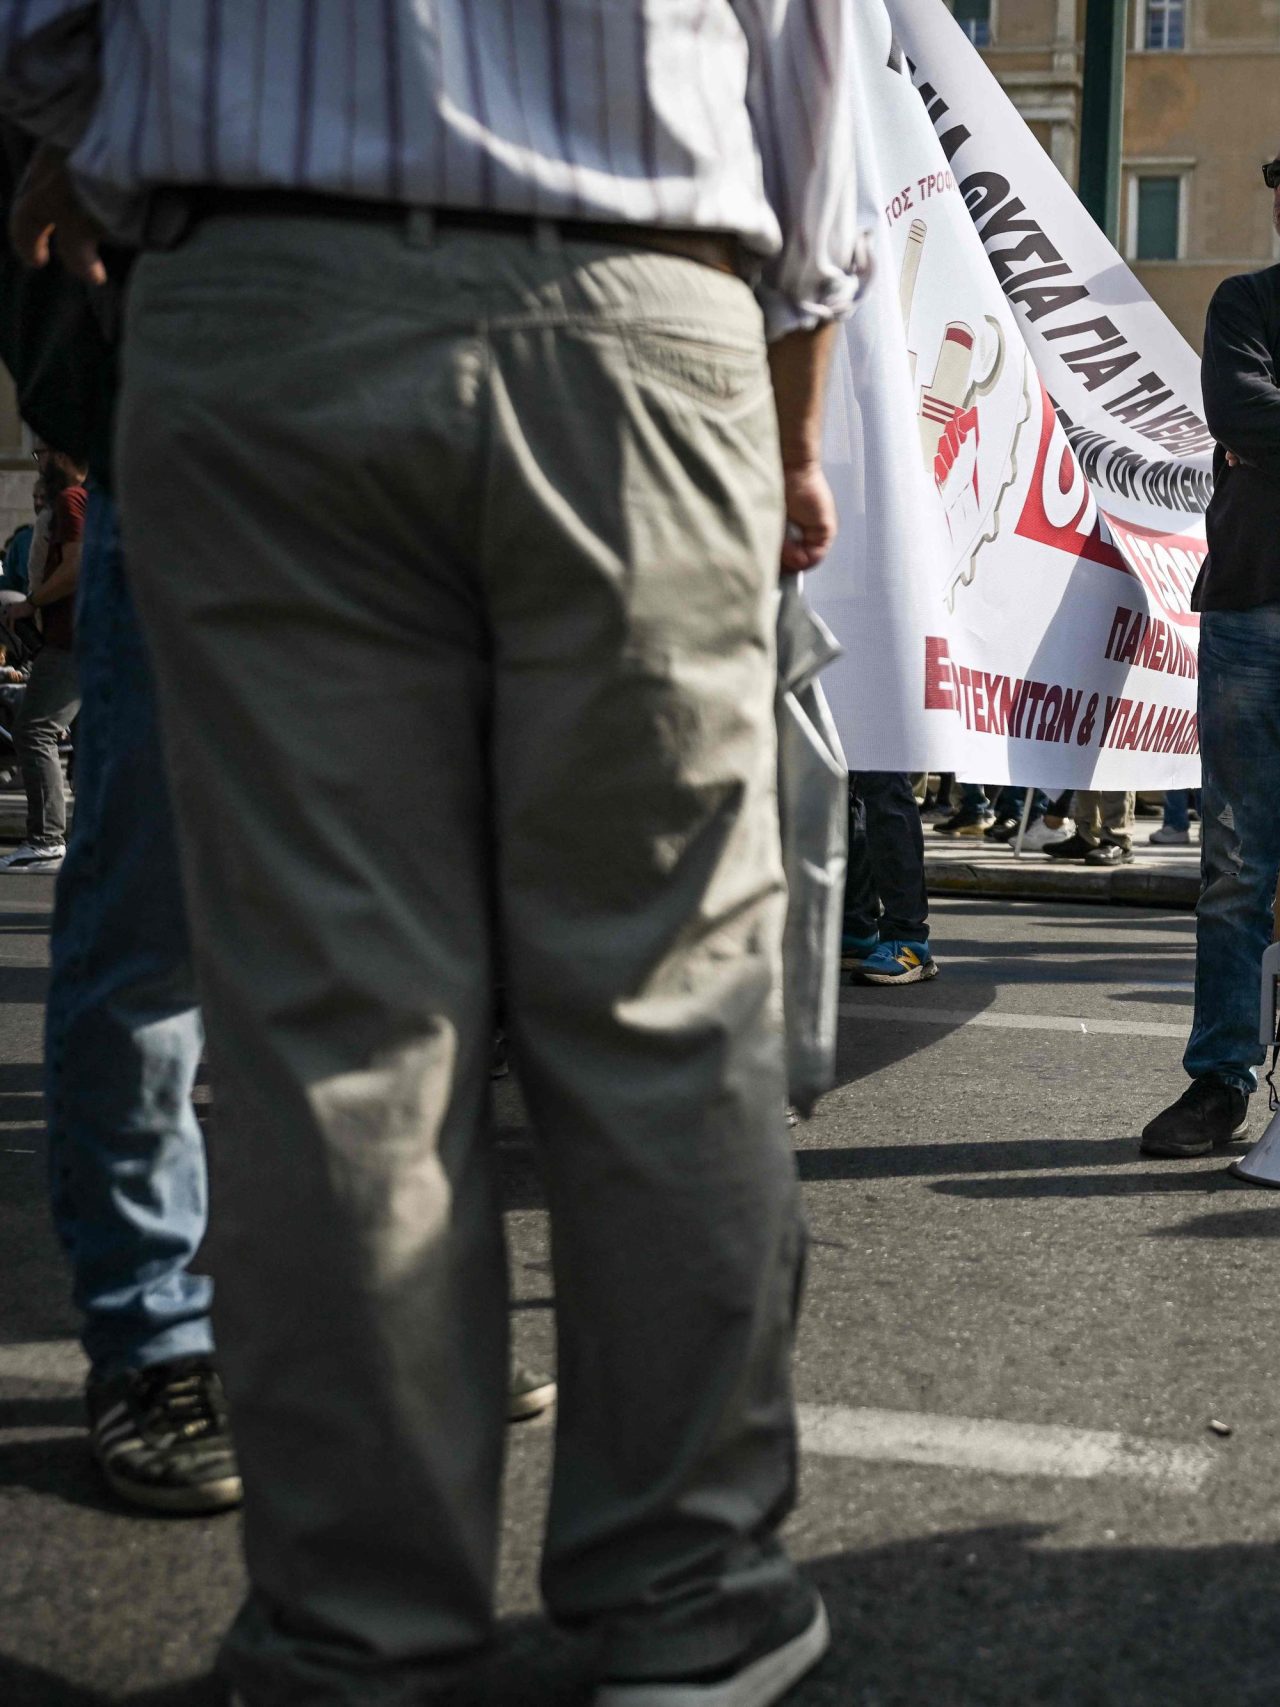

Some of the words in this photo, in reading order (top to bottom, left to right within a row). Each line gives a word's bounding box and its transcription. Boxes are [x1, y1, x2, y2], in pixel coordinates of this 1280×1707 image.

[1041, 315, 1142, 393] ΓΙΑ
[1101, 371, 1176, 425] ΤΑ
[1105, 446, 1149, 502] ΤΟΥ
[1104, 606, 1199, 680] ΠΑΝΕΛΛΗ
[1077, 692, 1100, 747] &
